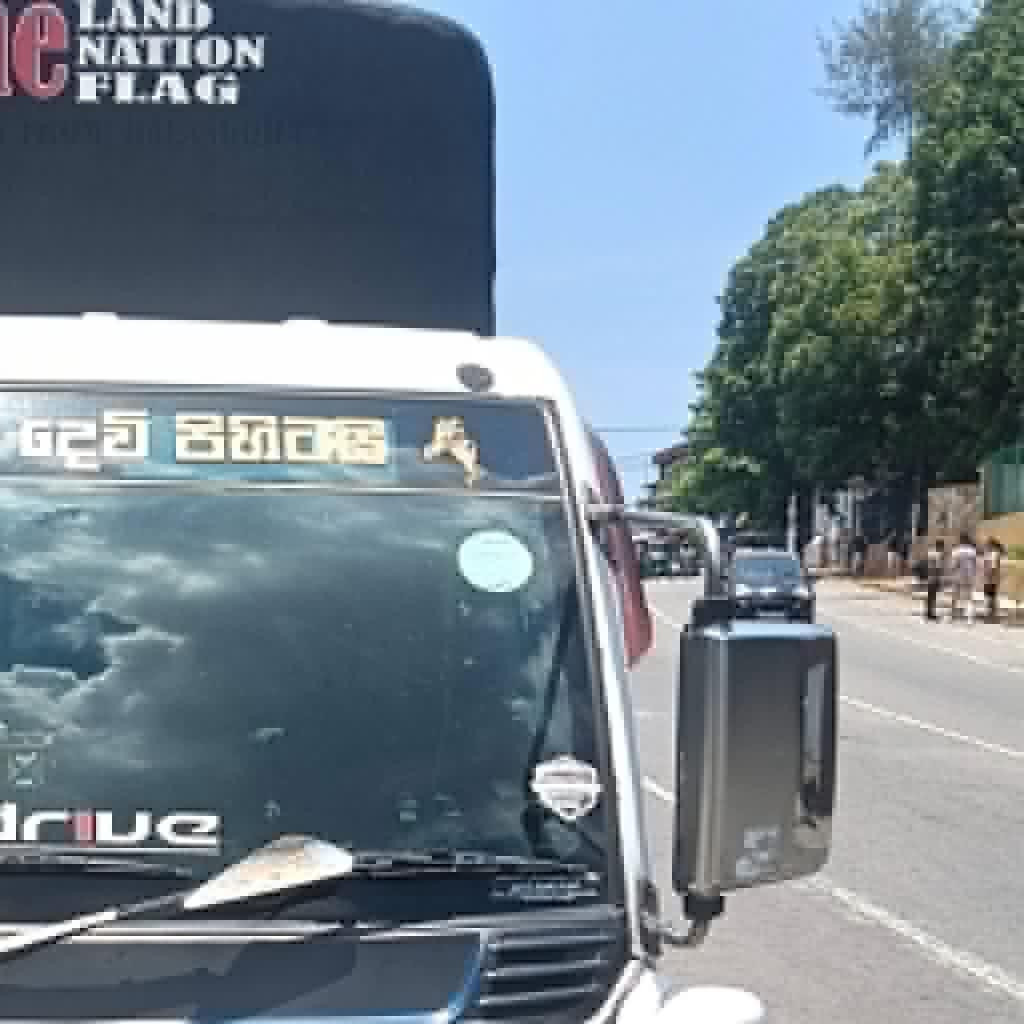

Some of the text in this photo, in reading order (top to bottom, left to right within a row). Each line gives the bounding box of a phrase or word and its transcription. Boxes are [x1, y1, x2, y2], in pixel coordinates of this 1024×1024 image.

[79, 0, 214, 29] LAND
[77, 36, 266, 68] NATION
[78, 72, 241, 104] FLAG
